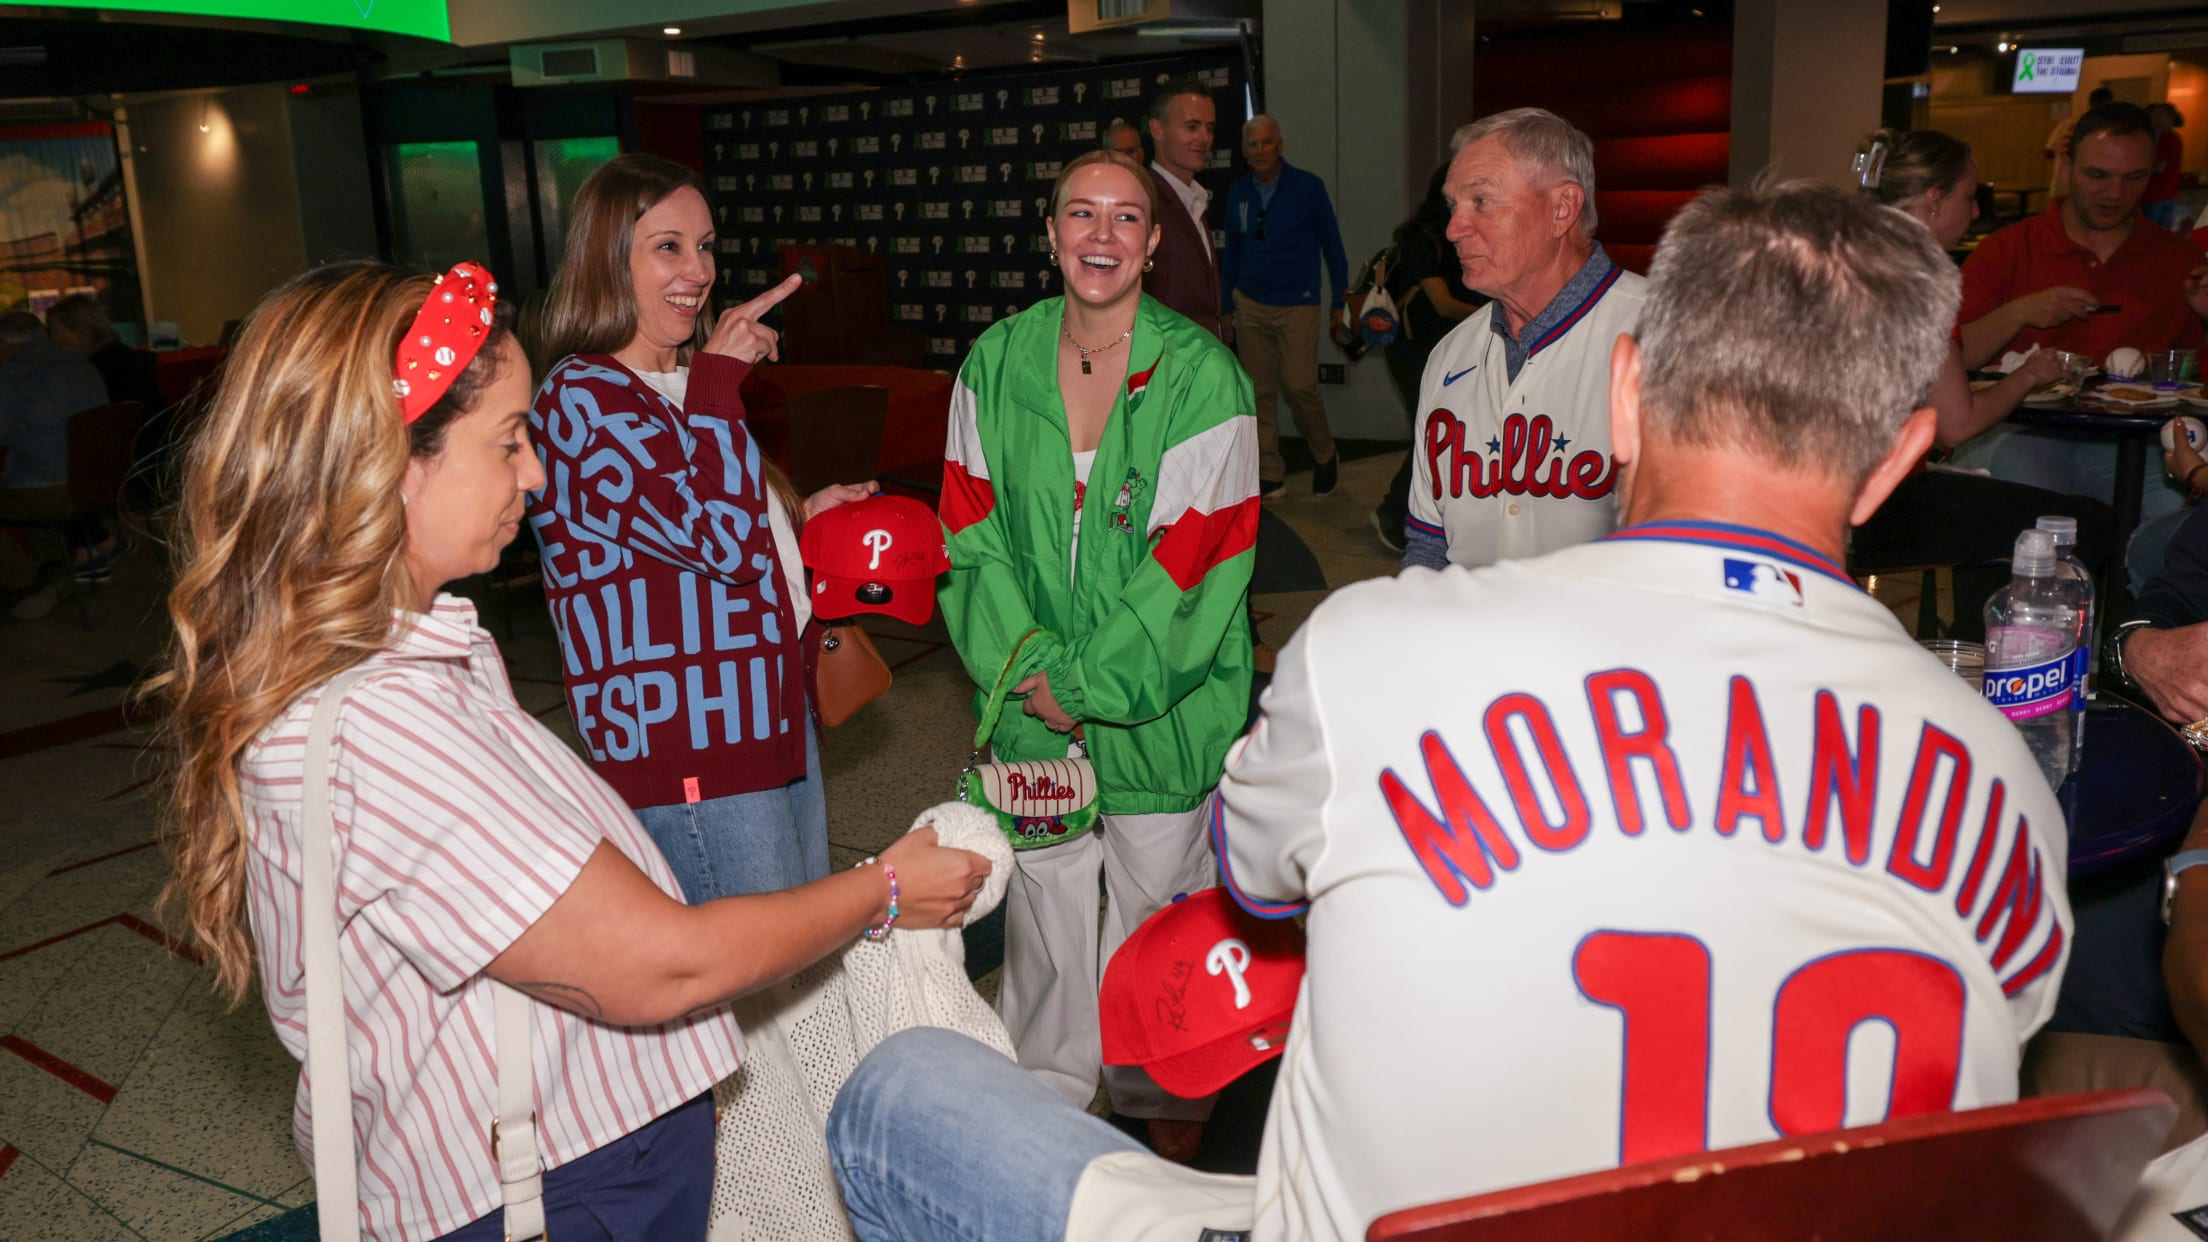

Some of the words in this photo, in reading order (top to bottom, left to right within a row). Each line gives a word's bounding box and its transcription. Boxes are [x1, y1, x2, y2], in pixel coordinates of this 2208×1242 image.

[1425, 408, 1619, 500] Phillie
[862, 529, 893, 570] P
[1986, 660, 2067, 698] propel
[2011, 709, 2031, 718] BERRY
[1007, 772, 1076, 801] Phillies
[1379, 667, 2064, 1001] MORANDINI
[1205, 938, 1251, 1009] P
